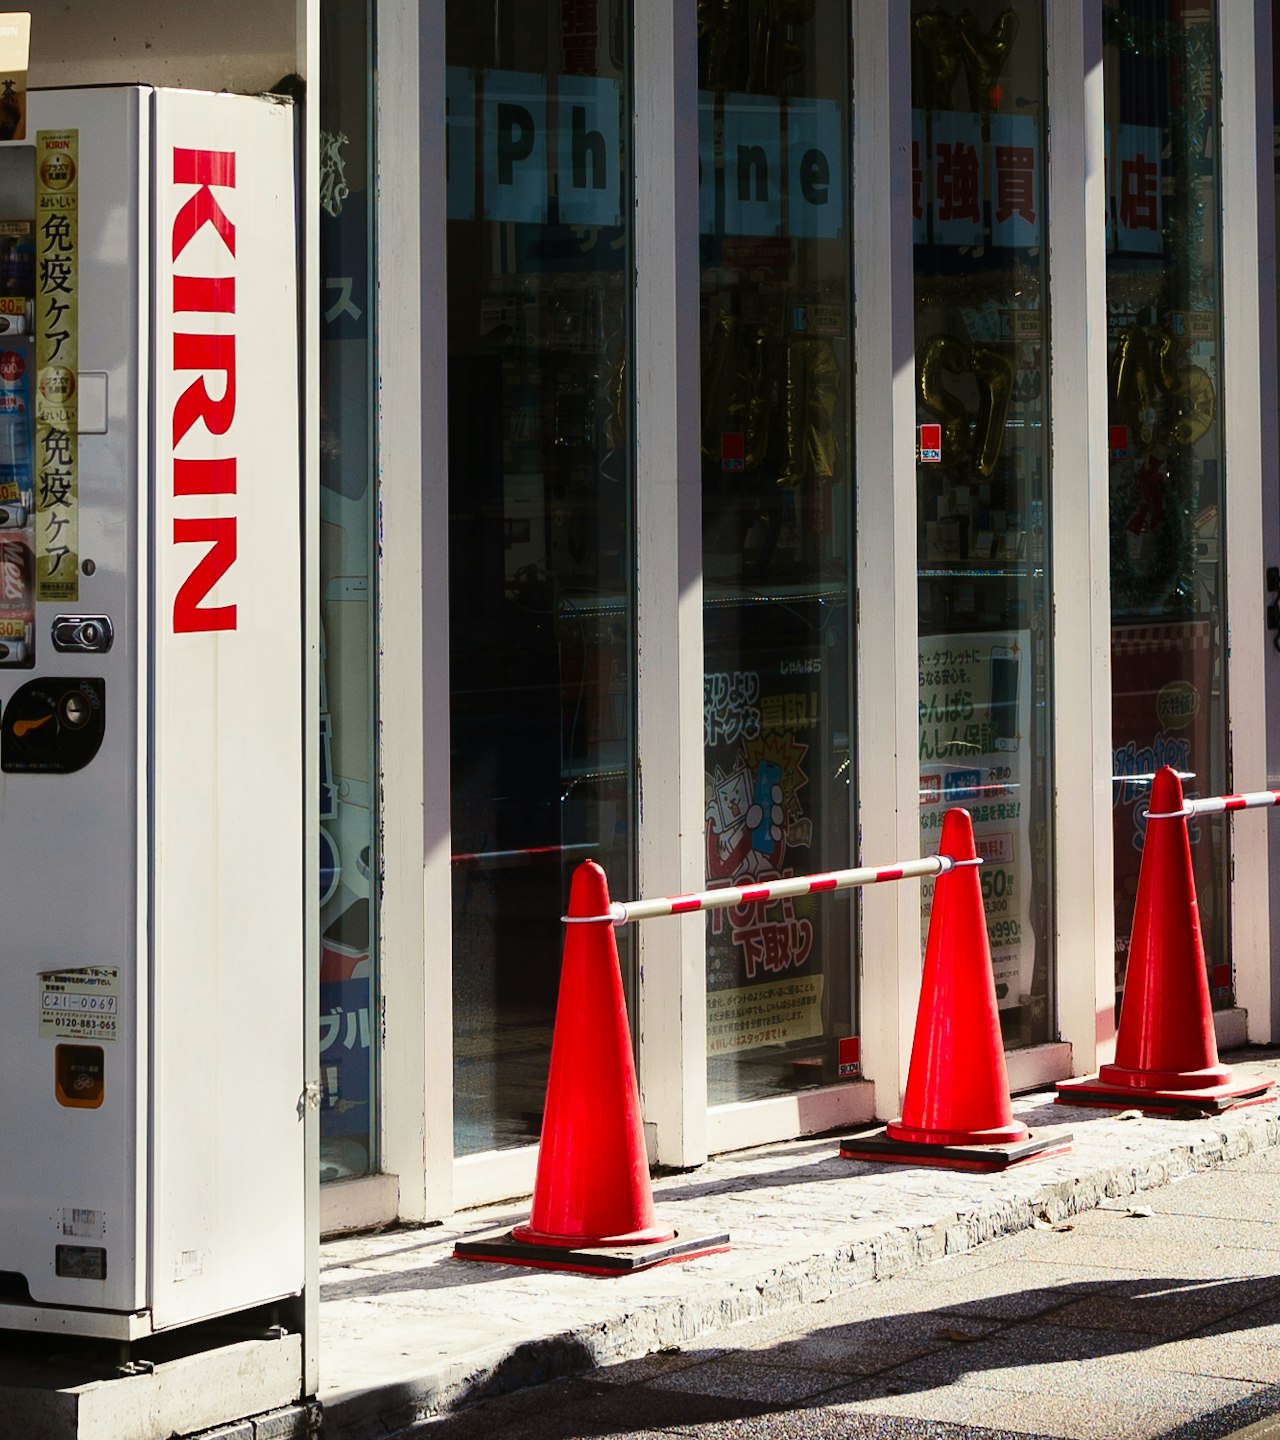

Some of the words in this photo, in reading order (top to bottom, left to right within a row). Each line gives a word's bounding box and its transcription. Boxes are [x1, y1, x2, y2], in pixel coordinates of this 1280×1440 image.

[45, 140, 70, 149] KIRIN
[40, 196, 75, 208] おいしい
[40, 212, 74, 361] 免疫ケア
[40, 408, 75, 420] おいしい
[171, 146, 238, 635] KIRIN
[39, 425, 73, 578] 免疫ケア
[761, 691, 818, 738] 買取!
[732, 918, 813, 979] 下取り
